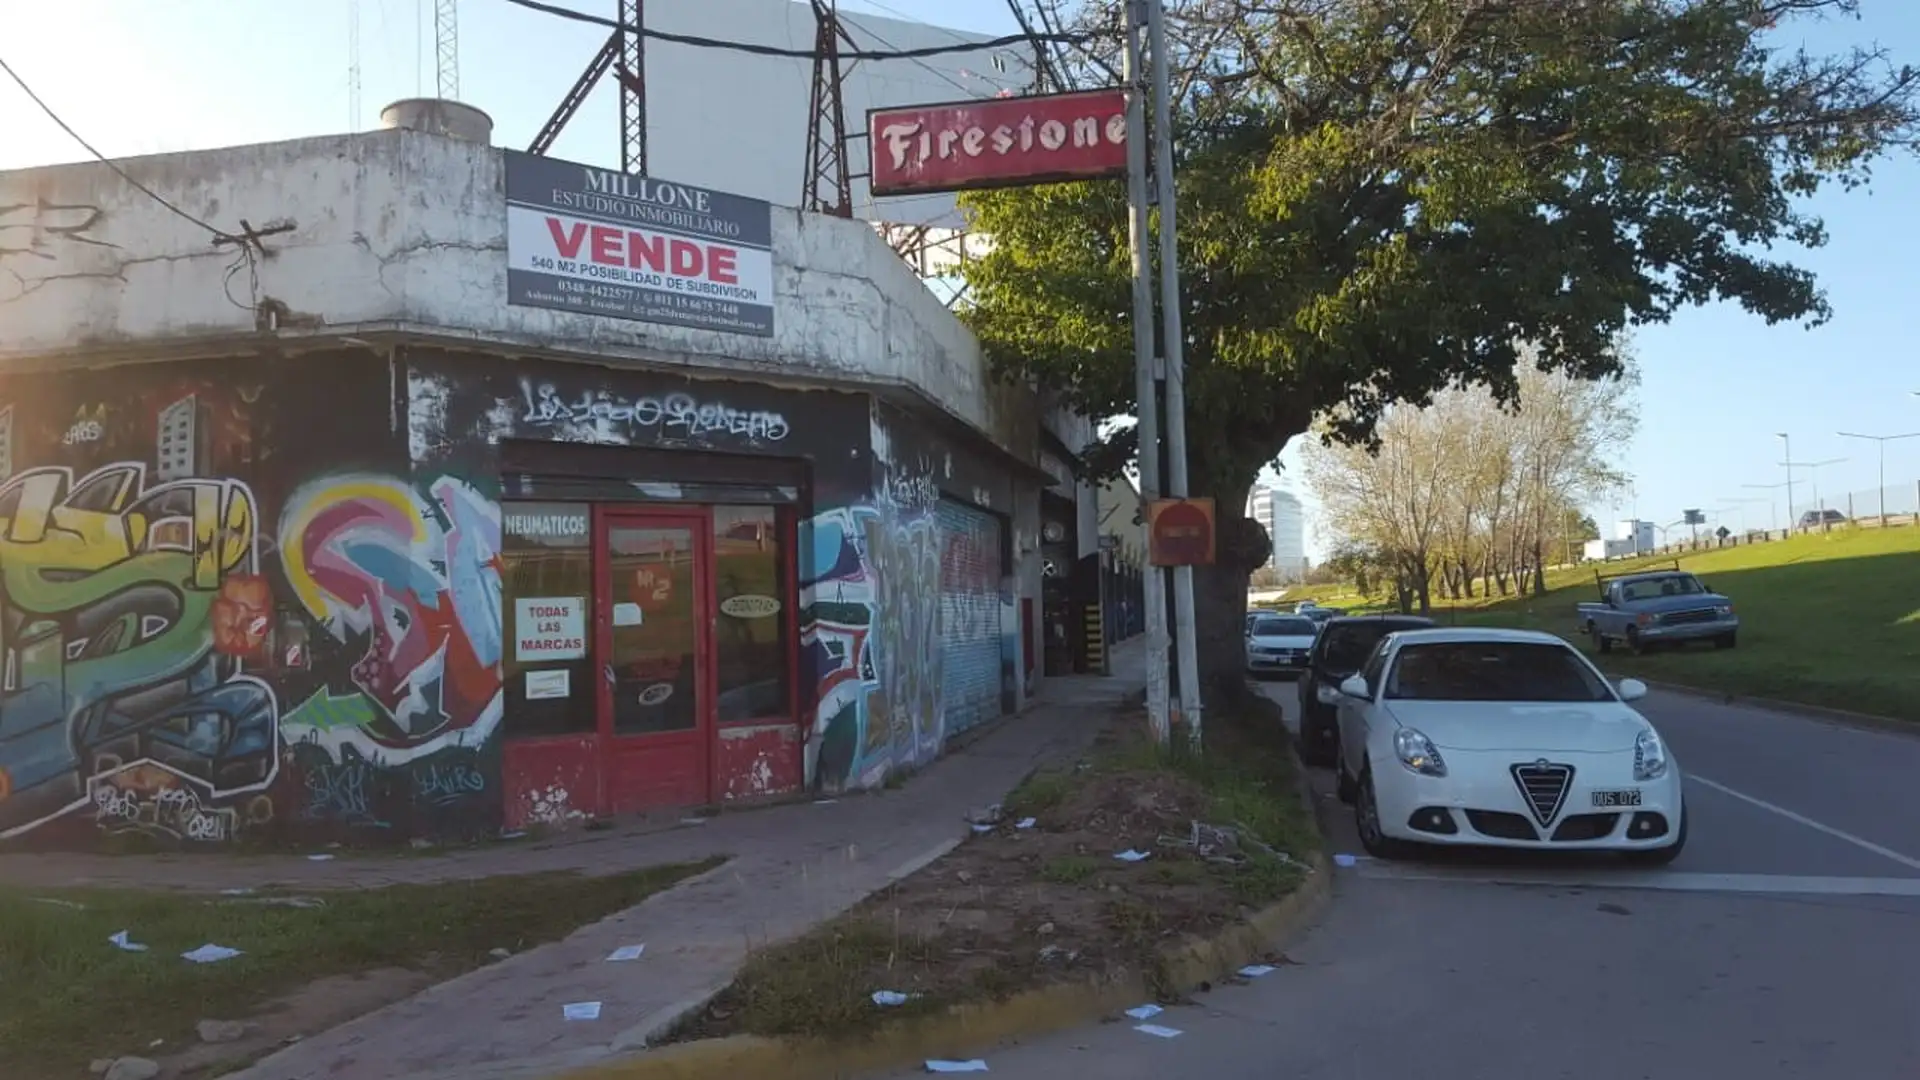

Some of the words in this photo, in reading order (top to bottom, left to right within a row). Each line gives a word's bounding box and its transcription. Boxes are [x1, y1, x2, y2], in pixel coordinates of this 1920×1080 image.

[882, 113, 1127, 171] Firestone
[585, 169, 712, 214] MILLONE
[552, 188, 626, 215] ESTUDIO
[630, 203, 740, 237] INMOBILIARIO
[546, 217, 739, 285] VENDE
[531, 255, 553, 270] 540
[557, 261, 577, 274] M2
[580, 264, 662, 287] POSIBILIDAD
[666, 278, 684, 290] DE
[505, 515, 586, 536] NEUMATICOS
[528, 606, 569, 618] TODAS
[537, 622, 561, 633] LAS
[521, 639, 582, 651] MARCAS
